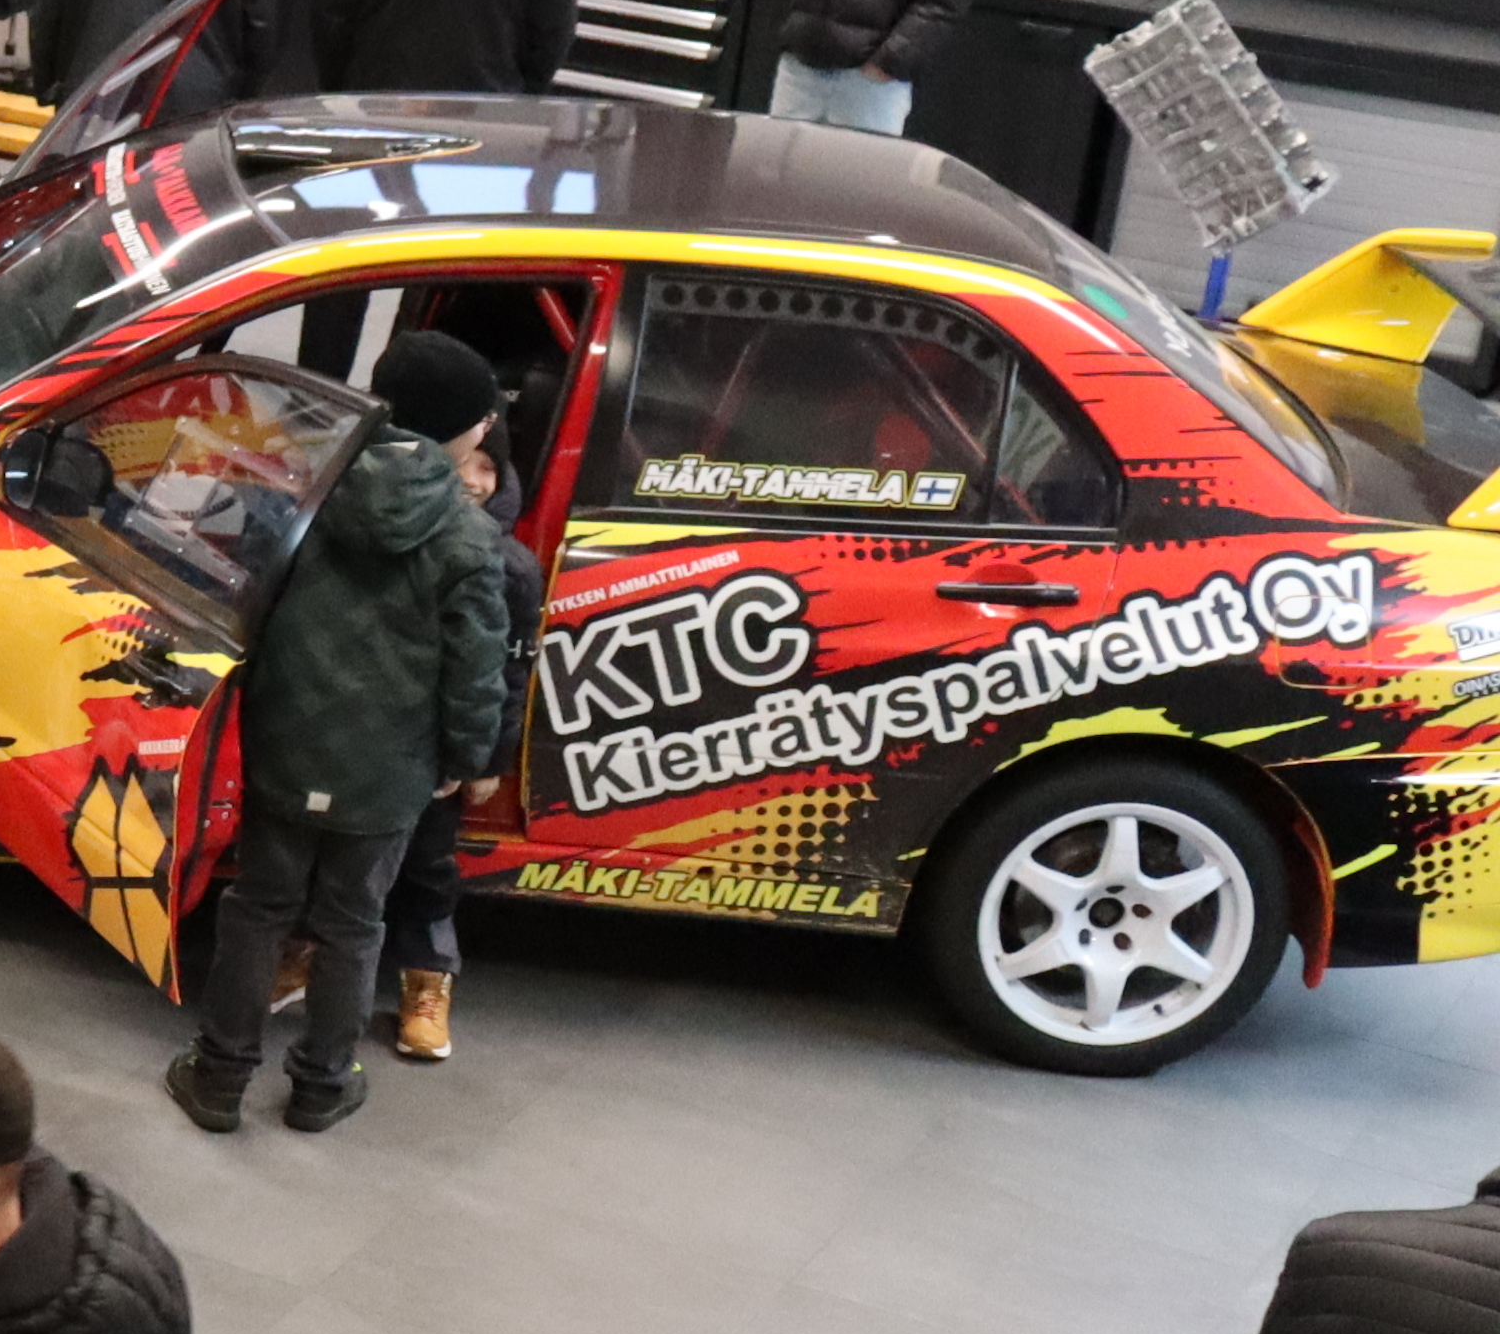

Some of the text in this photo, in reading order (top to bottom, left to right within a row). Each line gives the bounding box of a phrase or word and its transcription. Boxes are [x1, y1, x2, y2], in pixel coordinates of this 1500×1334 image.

[637, 455, 907, 506] MÄKI-TAMMELA
[609, 550, 740, 599] AMMATTILAINEN
[538, 576, 811, 734] KTC
[565, 556, 1374, 811] Kierrätyspalvelut Oy
[515, 859, 882, 918] MÄKI-TAMMELA
